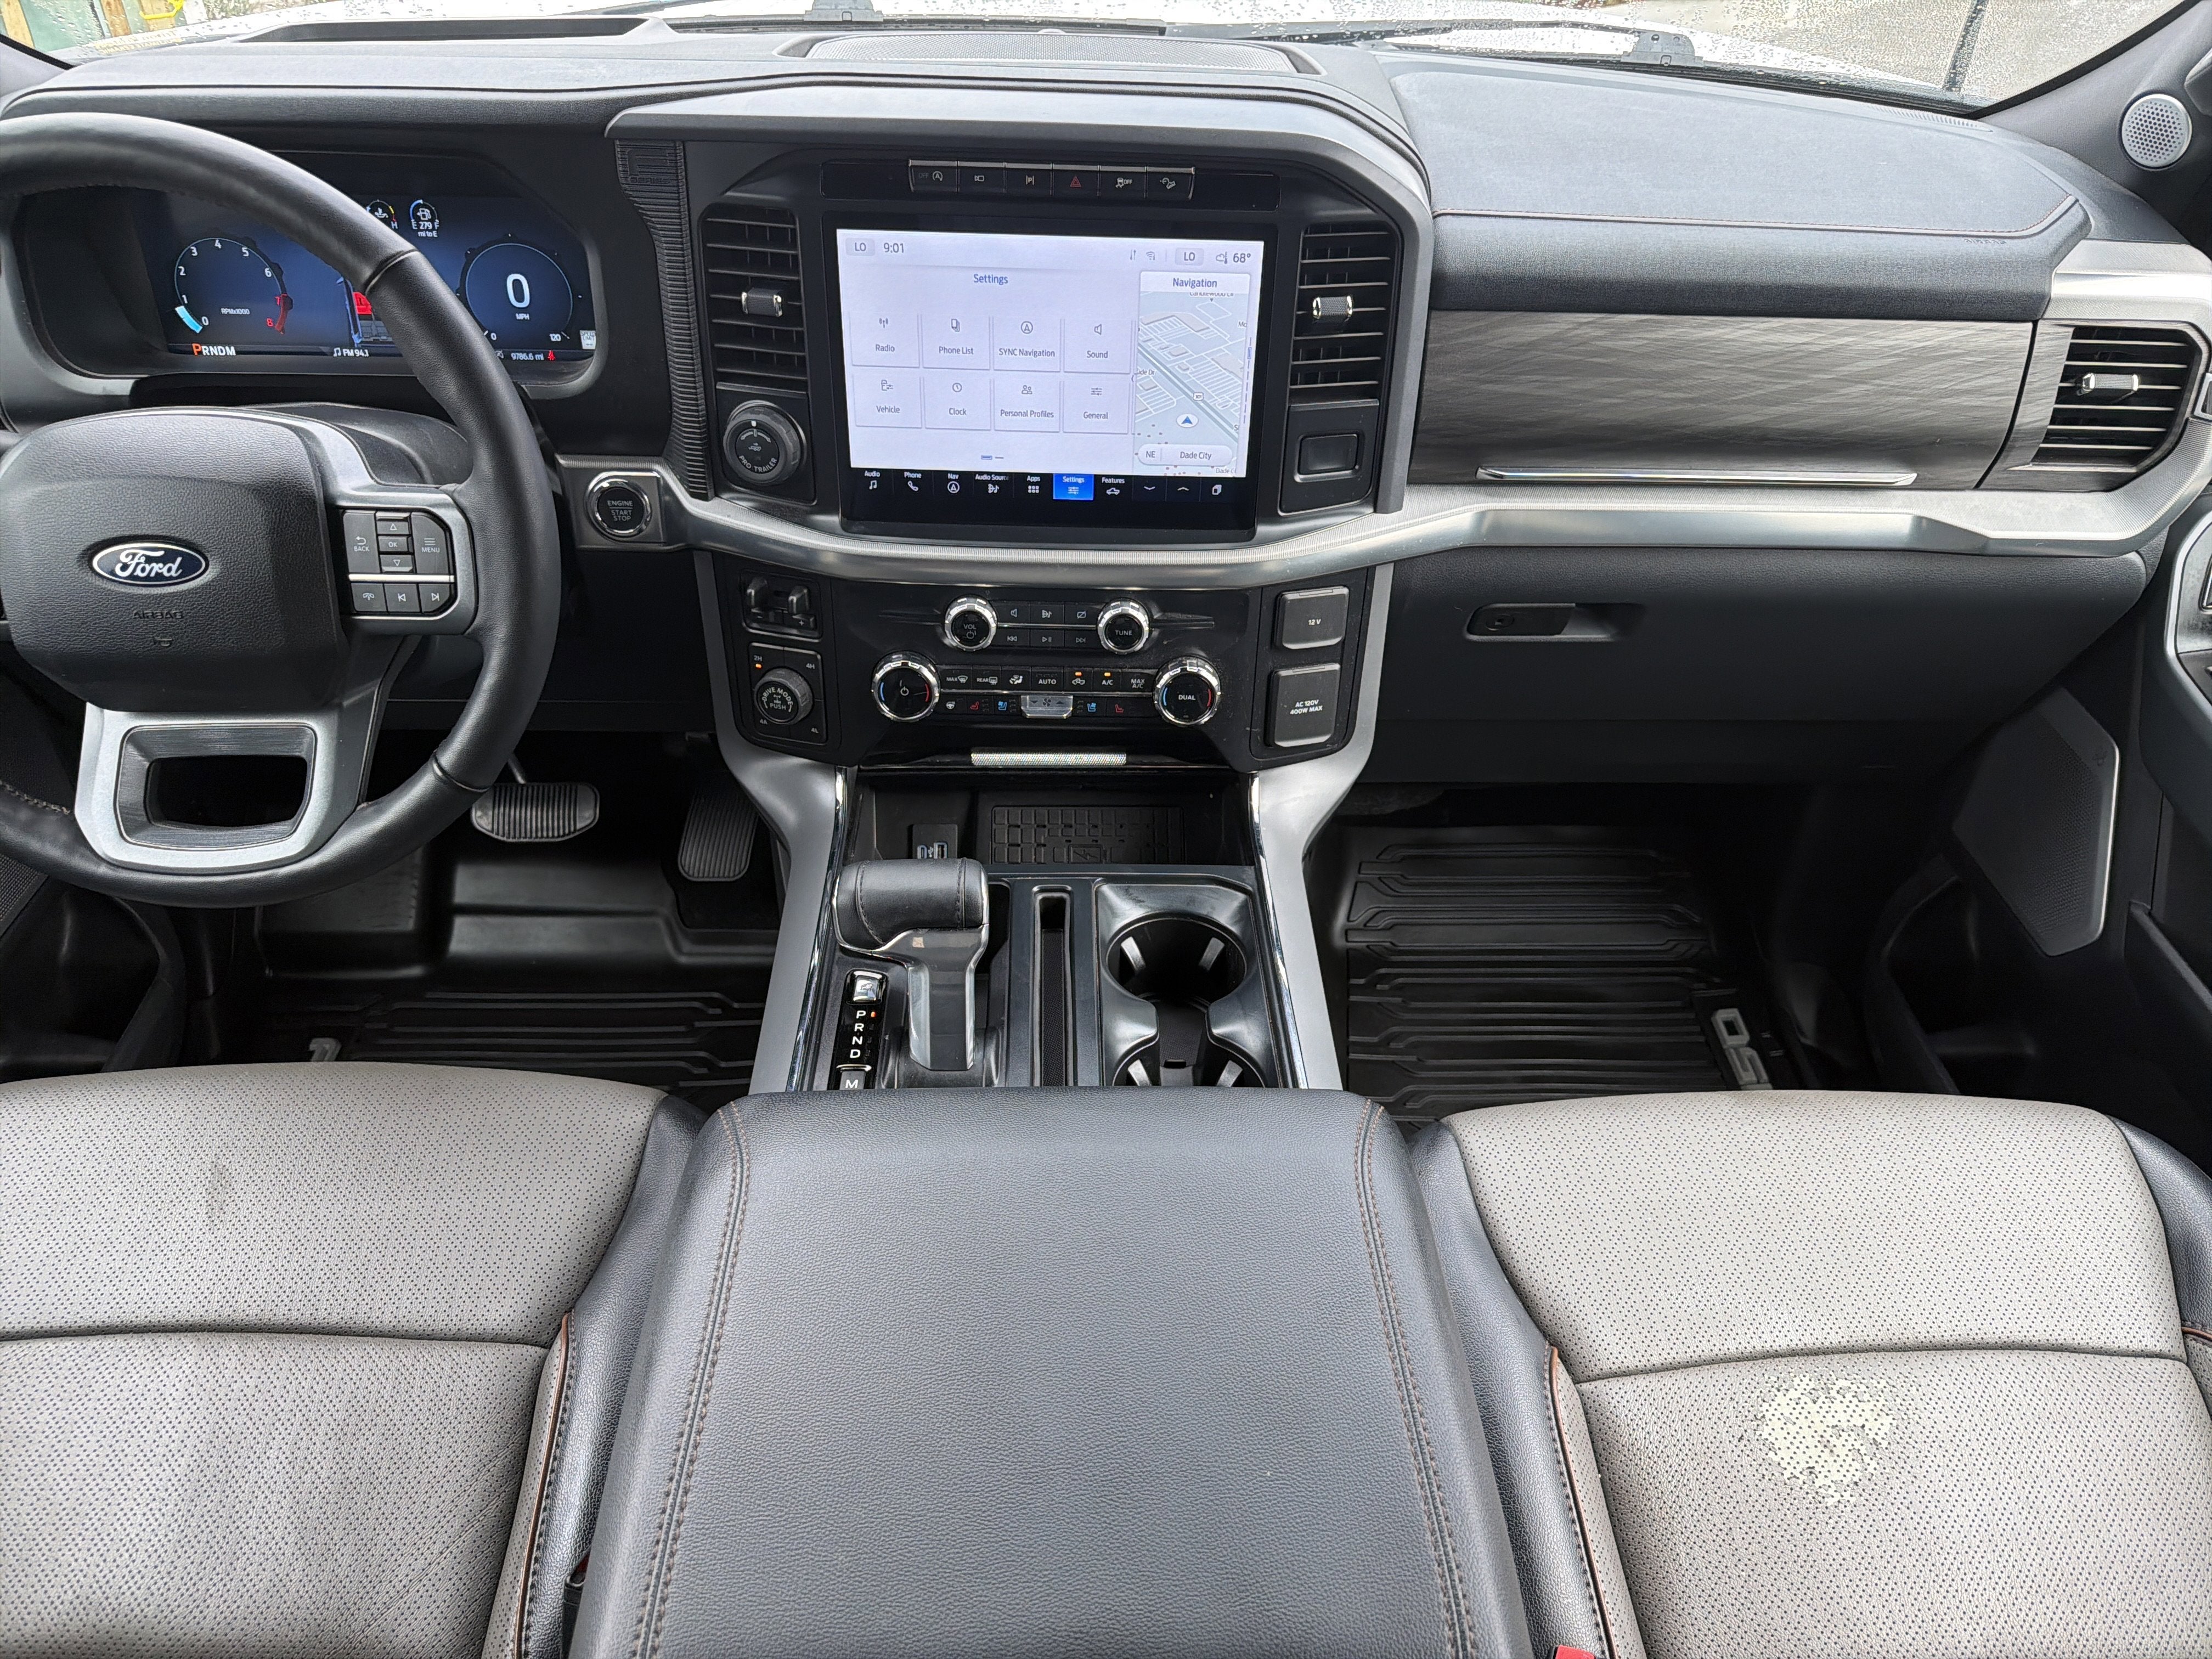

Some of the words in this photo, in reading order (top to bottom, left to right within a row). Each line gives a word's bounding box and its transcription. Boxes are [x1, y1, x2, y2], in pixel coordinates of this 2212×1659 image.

[391, 221, 398, 229] H
[412, 221, 417, 229] E
[435, 221, 439, 229] F
[215, 239, 222, 249] 4
[854, 242, 866, 252] LO
[883, 242, 905, 253] 9:01
[190, 247, 198, 256] 3
[241, 247, 249, 257] 5
[1183, 251, 1195, 261] LO
[1232, 252, 1251, 263] 68°
[178, 266, 186, 275] 2
[264, 268, 272, 277] 6
[973, 274, 1008, 285] Settings
[1172, 277, 1217, 289] Navigation
[506, 273, 531, 308] 0
[182, 295, 188, 304] 1
[275, 296, 281, 306] 7
[201, 317, 209, 325] 0
[266, 318, 273, 327] 8
[490, 332, 497, 341] 0
[354, 349, 369, 357] 94.1
[875, 344, 895, 353] Radio
[939, 346, 960, 355] Phone
[961, 346, 974, 355] List
[998, 347, 1018, 357] SYNC
[1018, 348, 1056, 358] Navigation
[1086, 350, 1108, 359] Sound
[876, 405, 900, 414] Vehicle
[949, 407, 967, 416] Clock
[1000, 409, 1029, 419] Personal
[1030, 409, 1054, 419] Profiles
[1083, 411, 1108, 420] General
[1198, 452, 1212, 460] City
[738, 455, 752, 470] PRO
[753, 457, 777, 473] TRAILER
[1026, 475, 1040, 483] Apps
[1062, 476, 1085, 484] Settings
[114, 549, 183, 578] Ford
[761, 687, 776, 702] DRIVE
[777, 687, 793, 705] MODE
[856, 1011, 866, 1019] P
[854, 1024, 864, 1032] R
[852, 1036, 863, 1045] N
[850, 1049, 861, 1058] D
[845, 1079, 859, 1089] M
